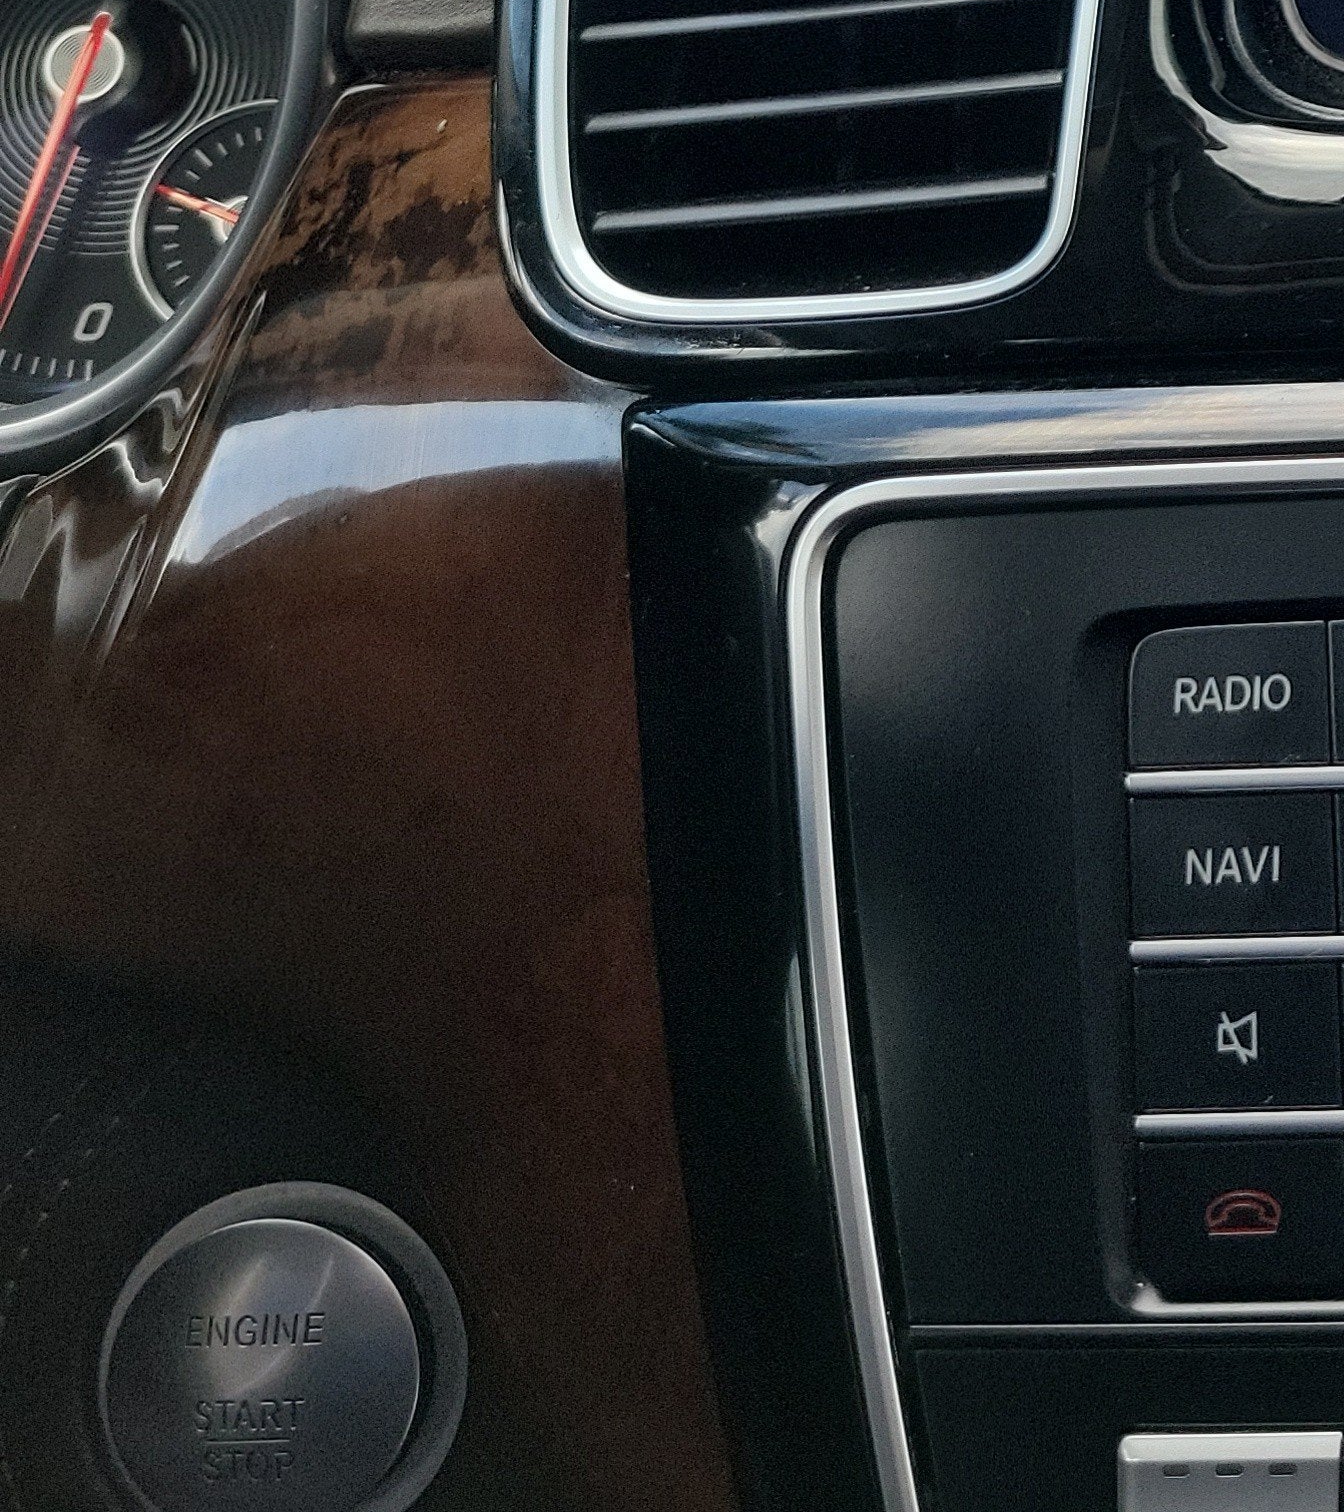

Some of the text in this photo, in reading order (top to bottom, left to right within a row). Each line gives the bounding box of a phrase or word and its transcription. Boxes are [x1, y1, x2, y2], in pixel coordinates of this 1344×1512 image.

[73, 302, 114, 342] 0
[1173, 672, 1292, 715] RADIO
[1184, 845, 1281, 886] NAVI
[185, 1311, 326, 1349] ENGINE
[195, 1398, 306, 1433] START
[201, 1450, 296, 1484] STOP
